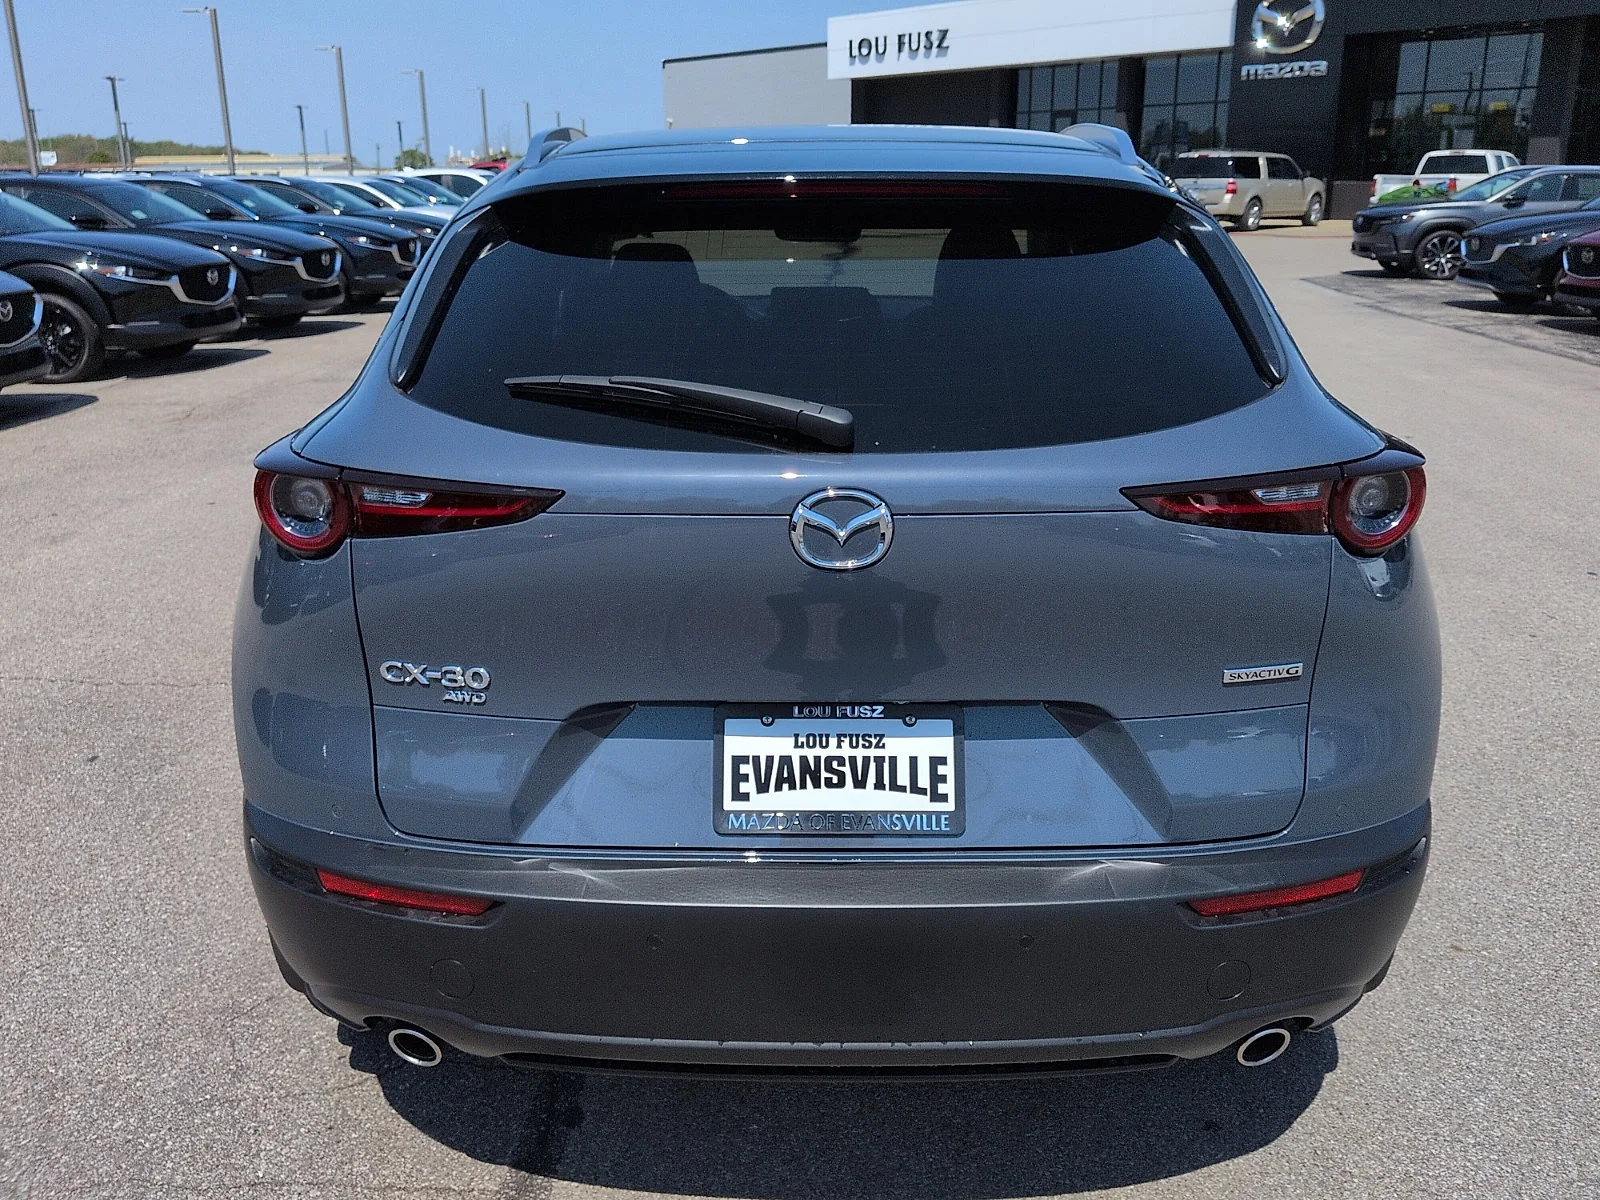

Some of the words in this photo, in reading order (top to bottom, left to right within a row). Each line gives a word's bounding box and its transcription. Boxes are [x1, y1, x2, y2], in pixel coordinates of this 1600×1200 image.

[849, 35, 887, 58] LOU
[897, 29, 950, 53] FUSZ
[380, 661, 491, 689] CX-30
[793, 705, 831, 718] LOU
[836, 705, 885, 718] FUSZ
[793, 733, 830, 749] LOU
[836, 733, 886, 749] FUSZ
[731, 755, 949, 803] EVANSVILLE
[728, 813, 803, 830] MAZDA
[809, 814, 836, 830] OF
[841, 814, 950, 831] EVANSVILLE
